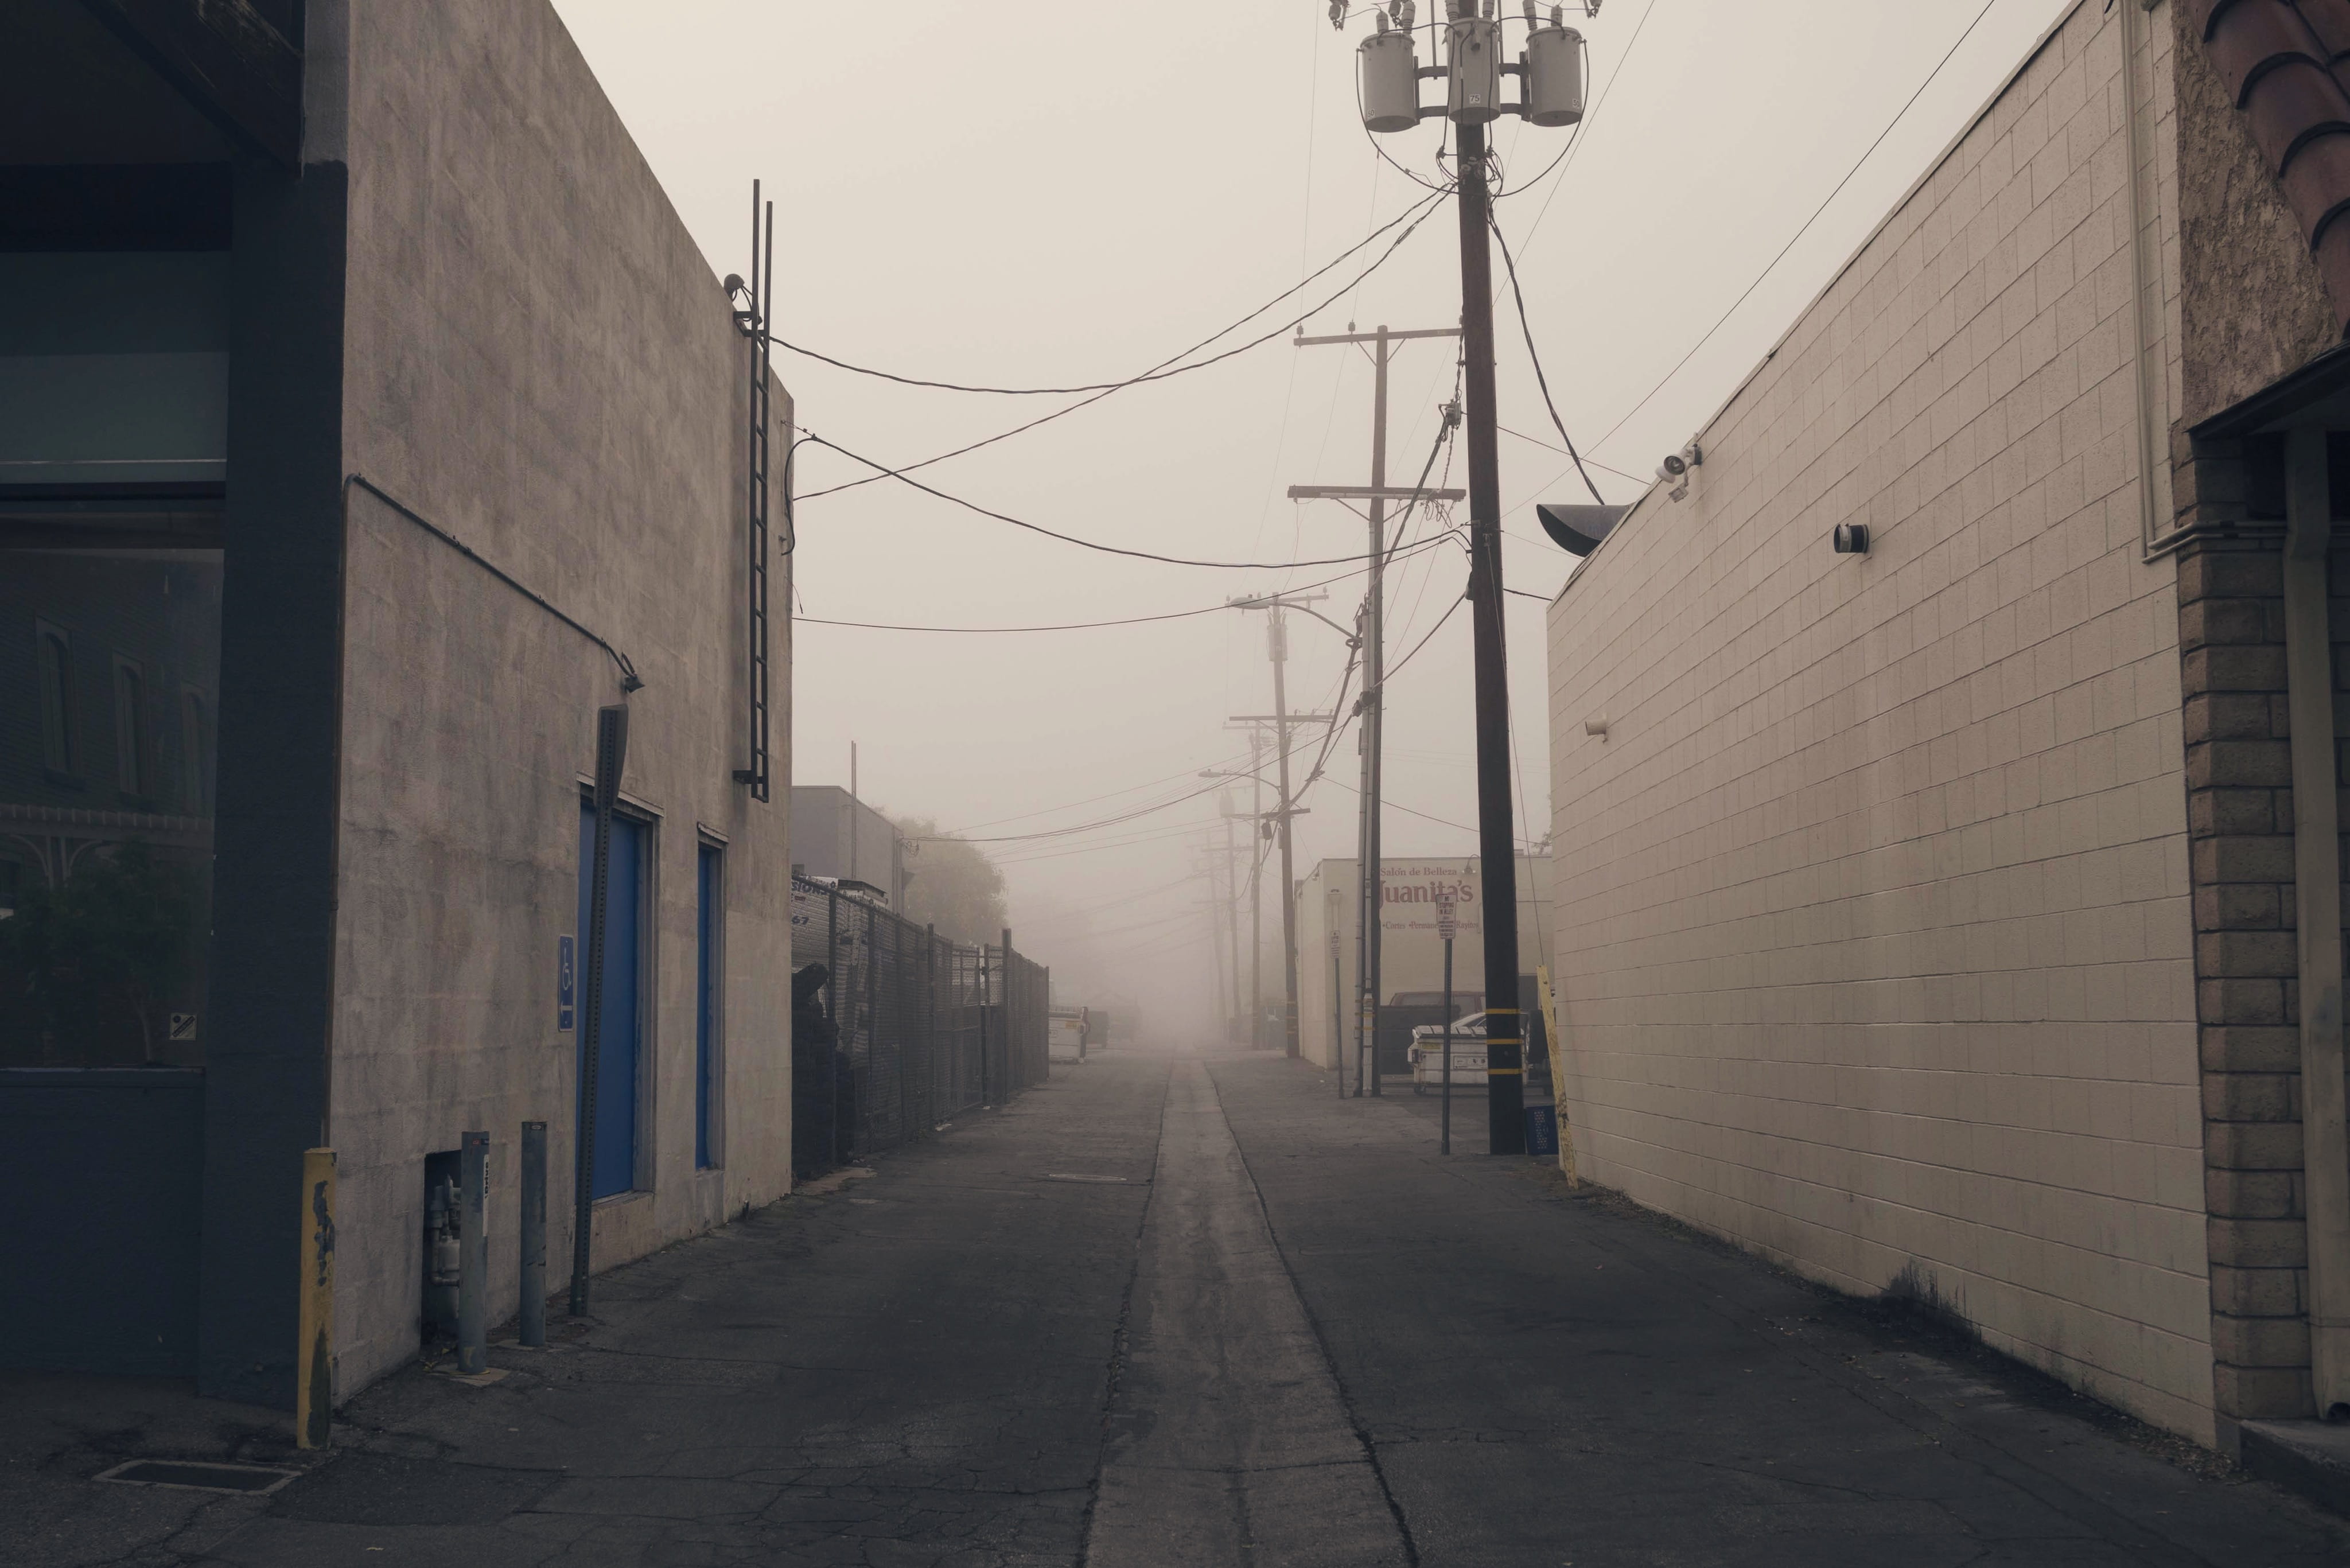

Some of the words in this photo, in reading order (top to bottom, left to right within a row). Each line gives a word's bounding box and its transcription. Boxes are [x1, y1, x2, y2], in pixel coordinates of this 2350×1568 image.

[1380, 867, 1406, 876] Salón
[1409, 867, 1421, 876] de
[1423, 867, 1457, 876] Belleza
[1386, 921, 1405, 929] Cortes
